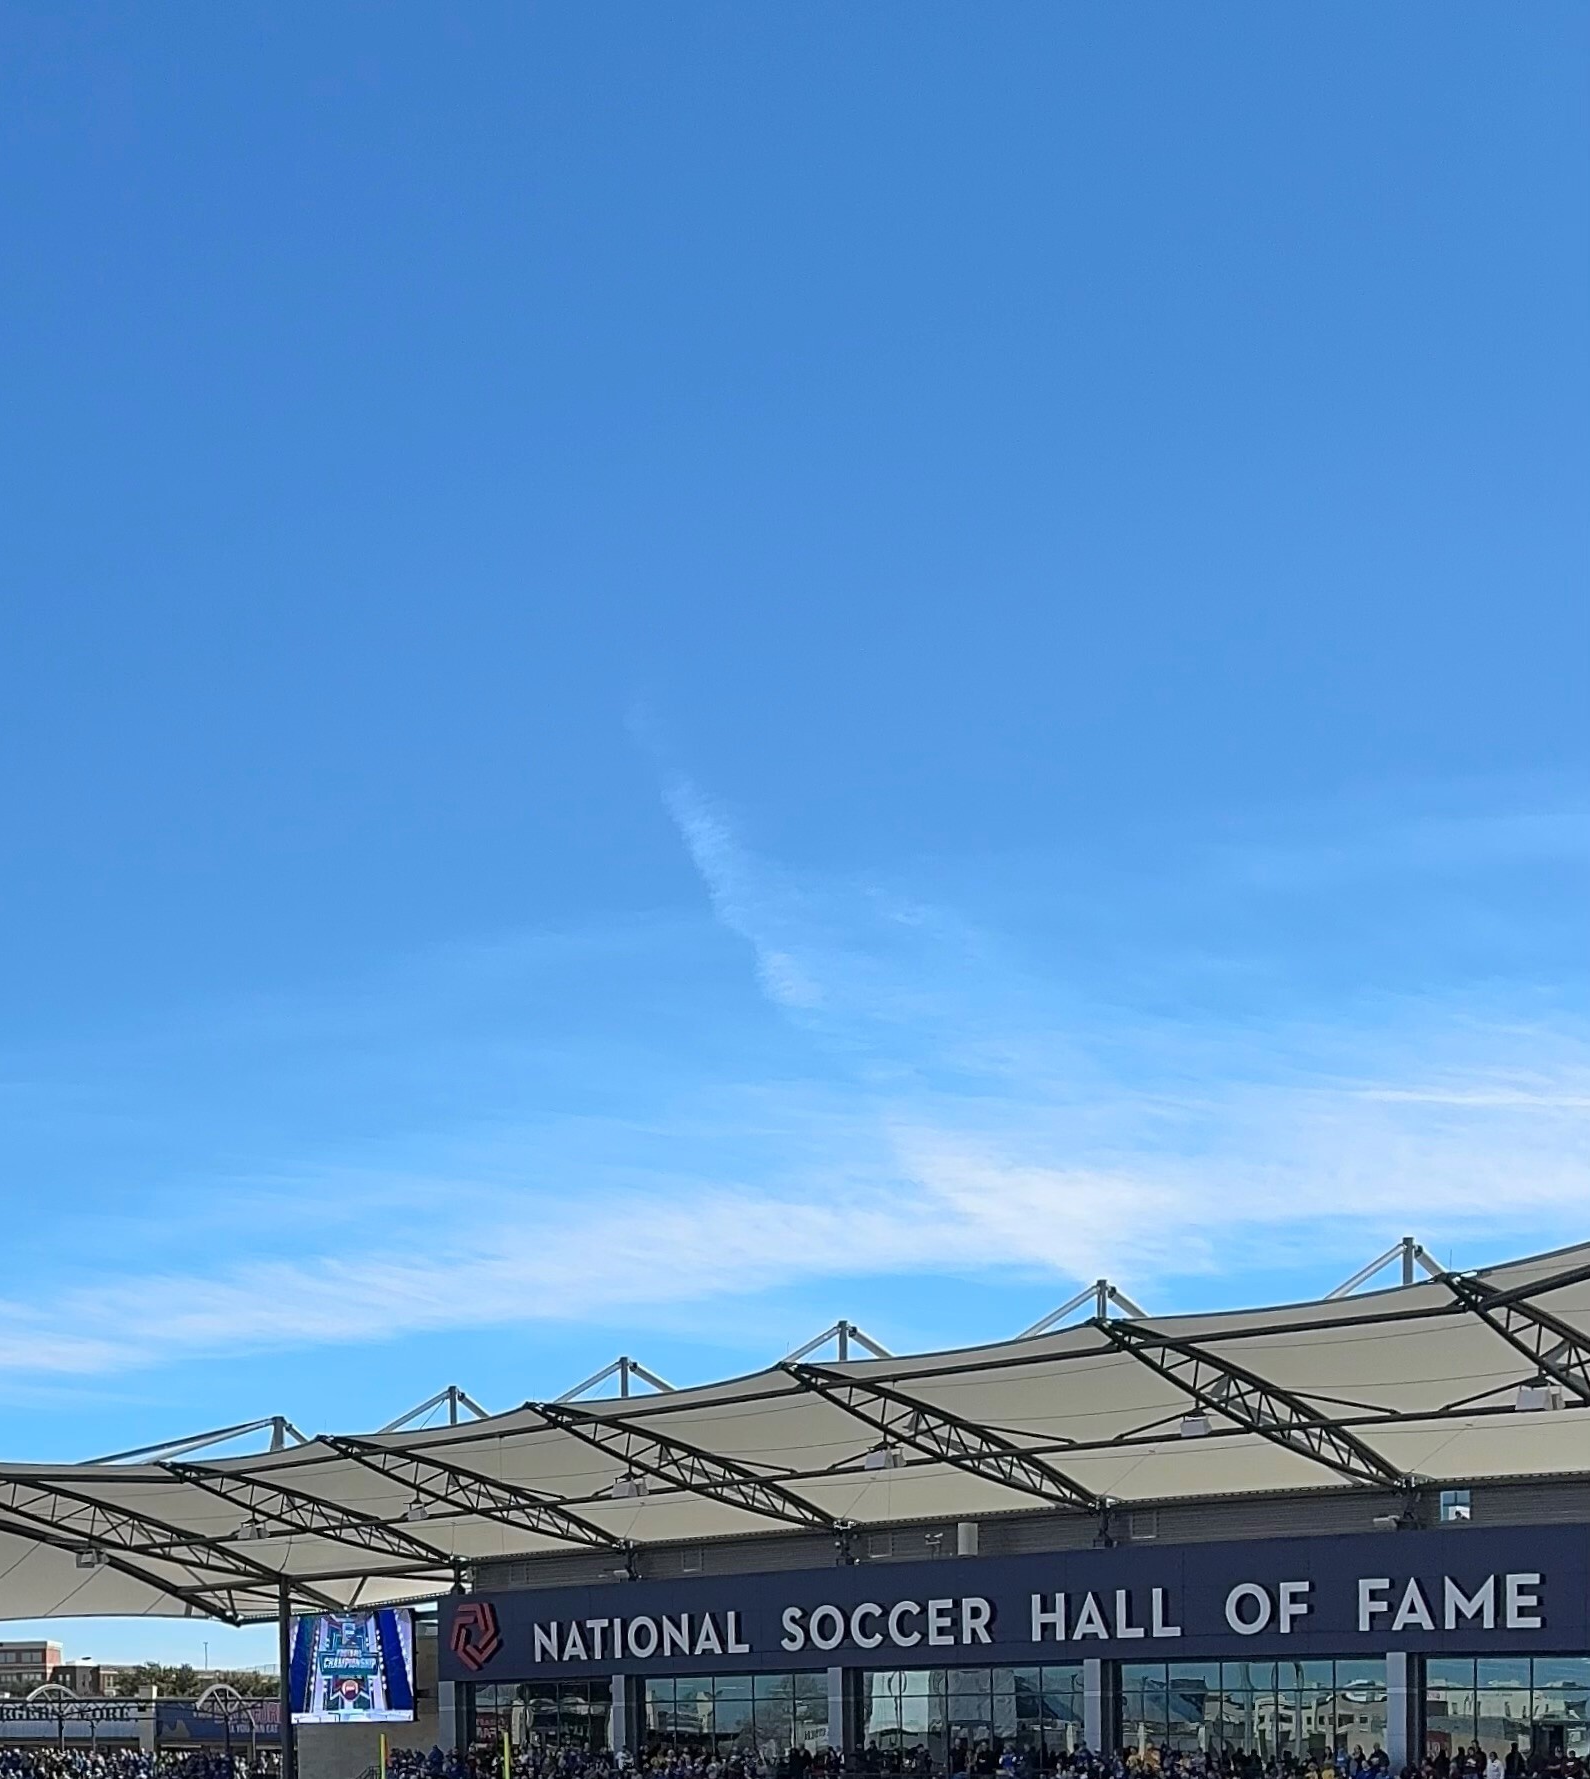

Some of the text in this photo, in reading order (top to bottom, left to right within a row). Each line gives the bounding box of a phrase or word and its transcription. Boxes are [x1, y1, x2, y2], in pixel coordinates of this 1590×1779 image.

[533, 1573, 1541, 1662] NATIONAL SOCCER HALL OF FAME
[324, 1658, 377, 1668] CHAMPIONSHIP
